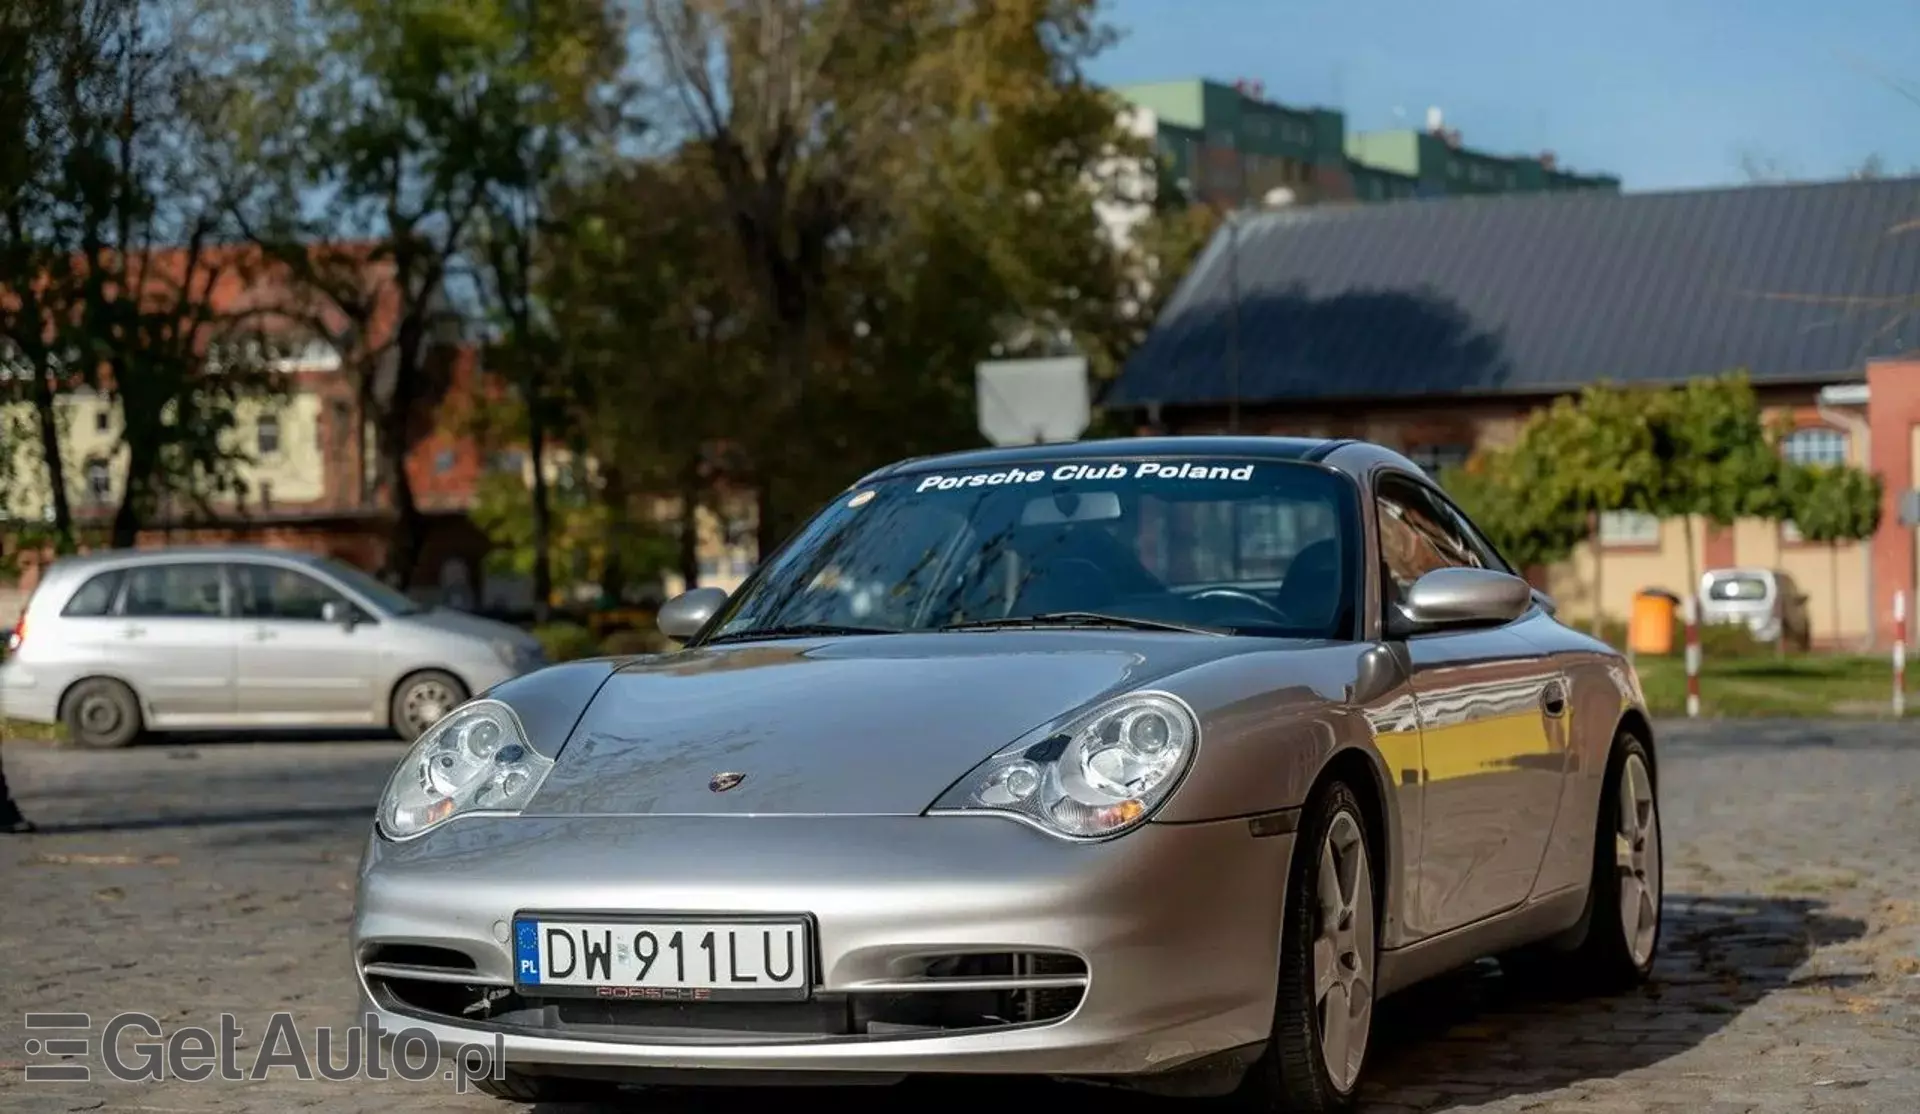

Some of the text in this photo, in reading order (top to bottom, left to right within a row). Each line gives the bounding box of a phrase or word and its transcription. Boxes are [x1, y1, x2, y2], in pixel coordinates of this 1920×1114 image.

[916, 463, 1255, 493] Porsche Club Poland
[547, 928, 794, 983] DW 911LU
[521, 960, 536, 973] PL
[597, 987, 711, 999] PORSCHE
